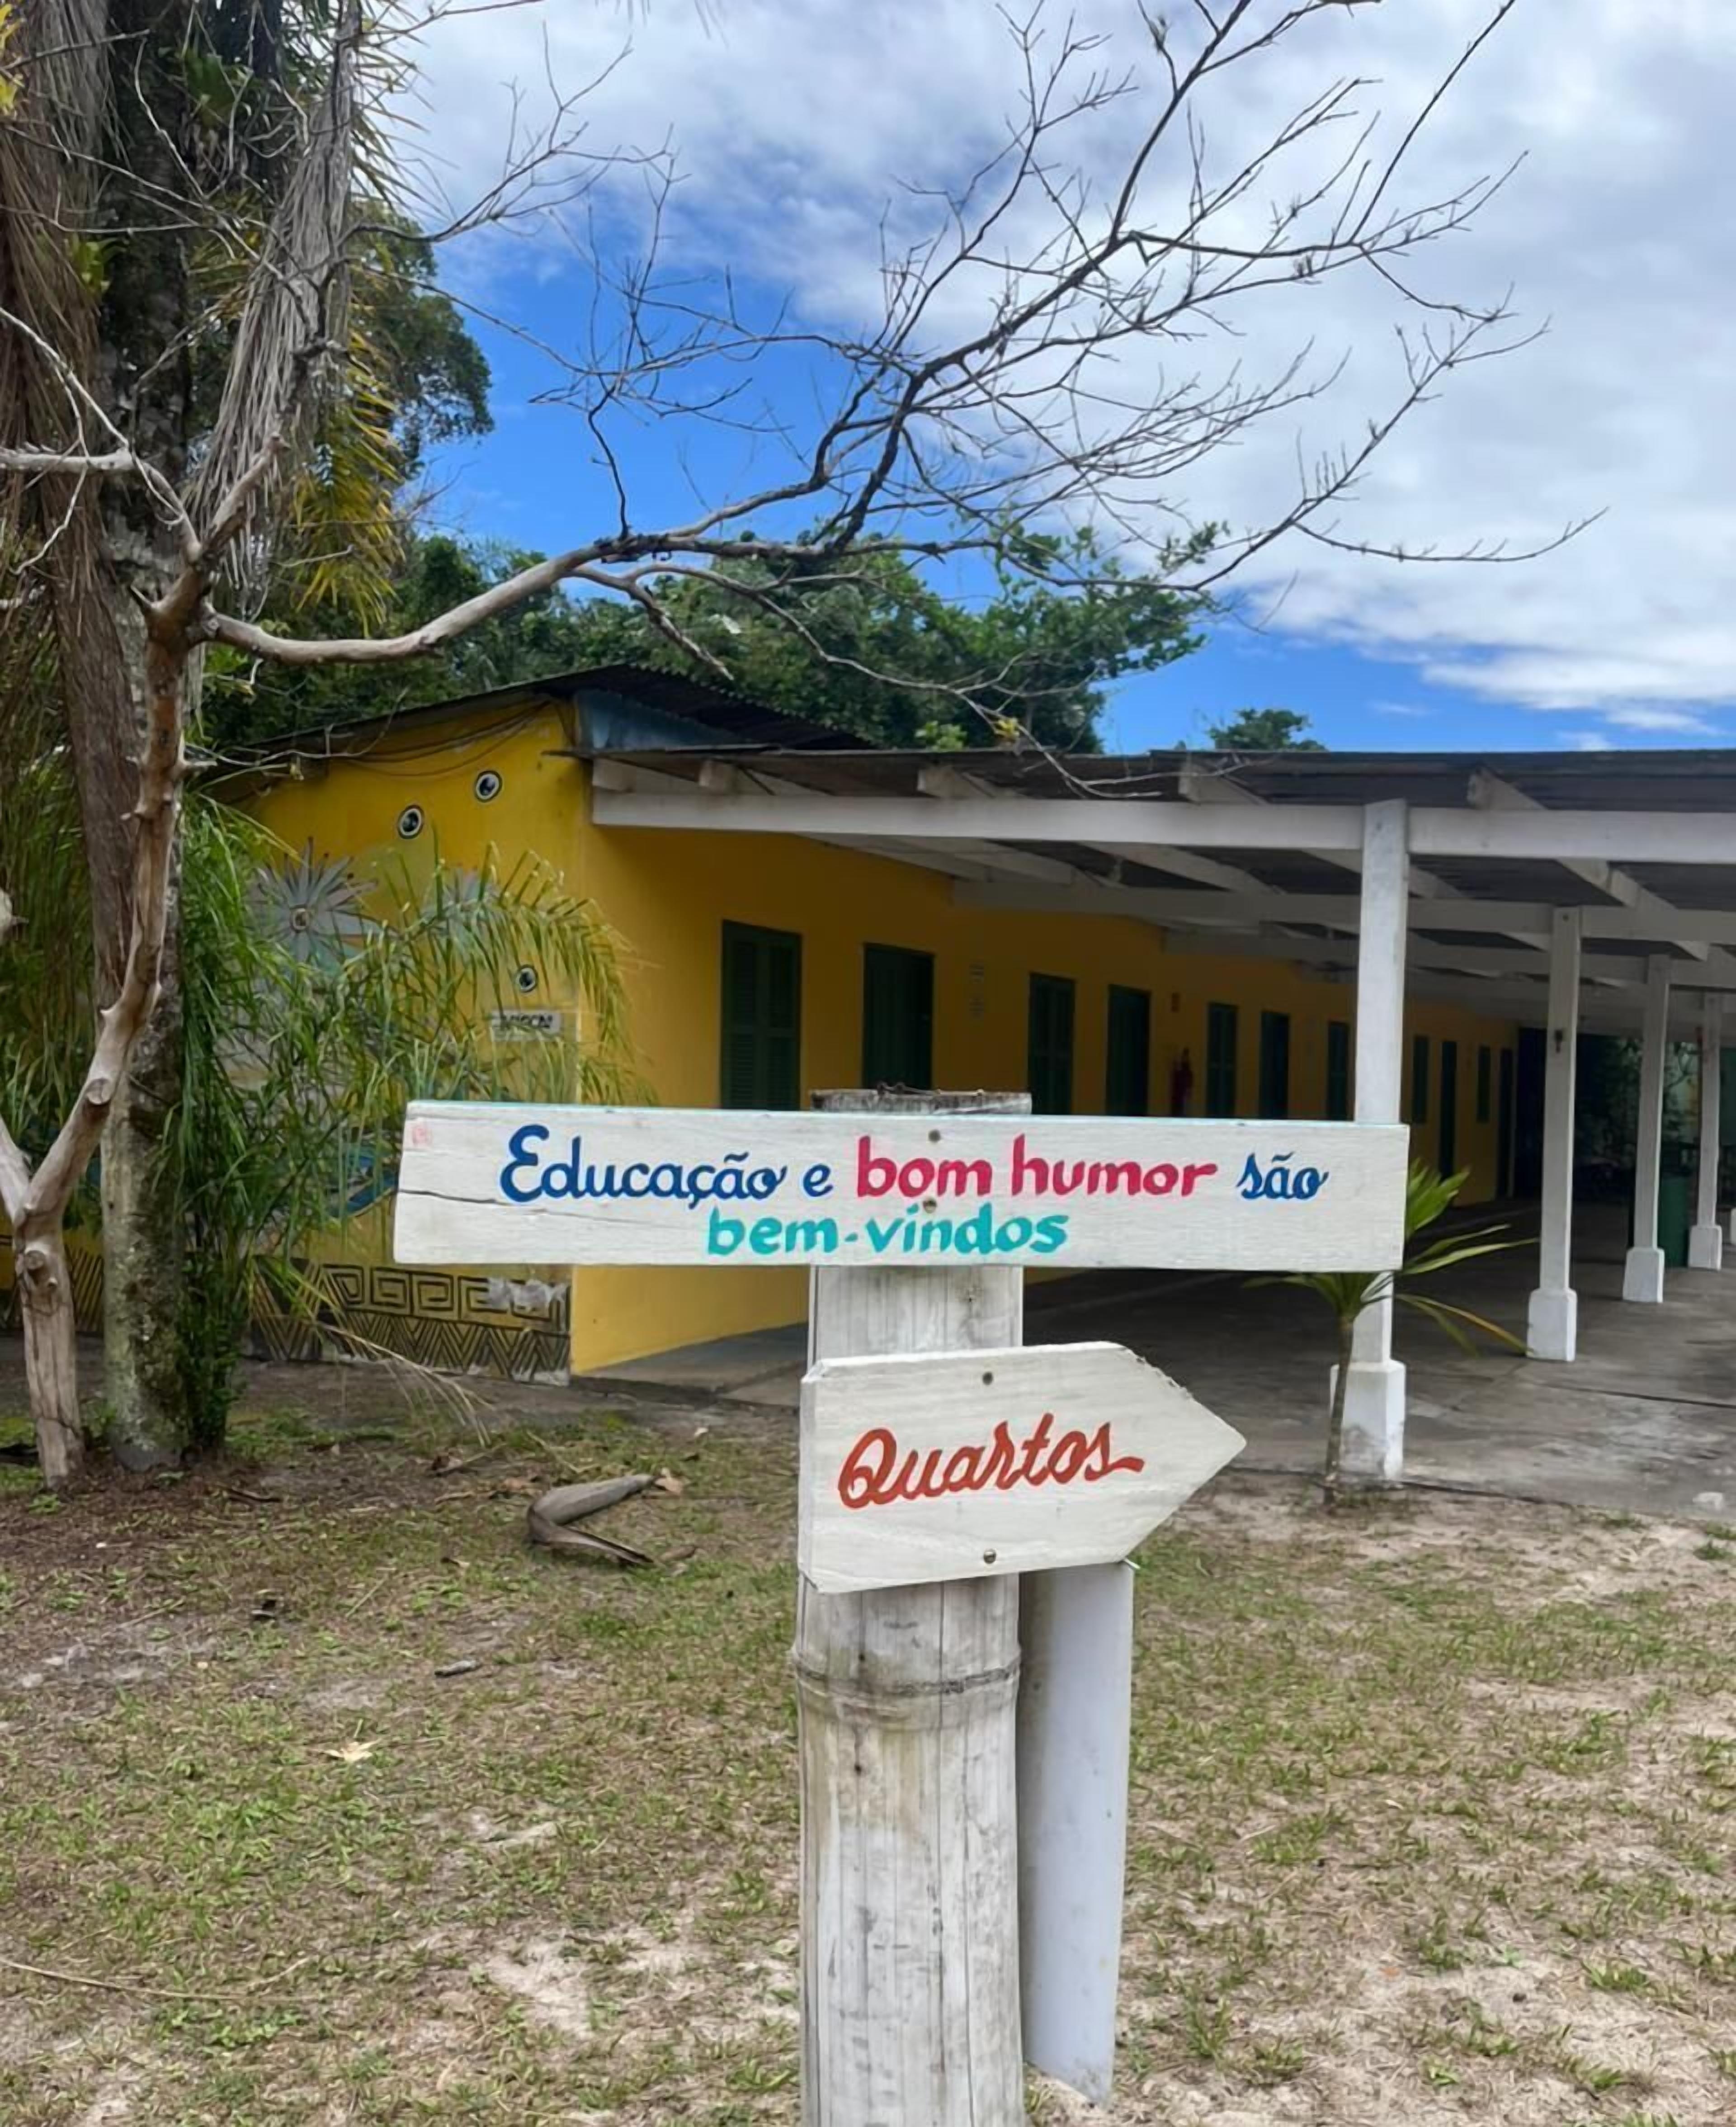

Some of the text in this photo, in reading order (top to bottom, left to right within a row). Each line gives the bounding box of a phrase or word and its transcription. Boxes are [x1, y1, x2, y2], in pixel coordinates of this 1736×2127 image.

[500, 1124, 1328, 1209] Educação e bom humor são
[707, 1202, 1068, 1257] bem-vindos
[838, 1413, 1144, 1509] Quartos
